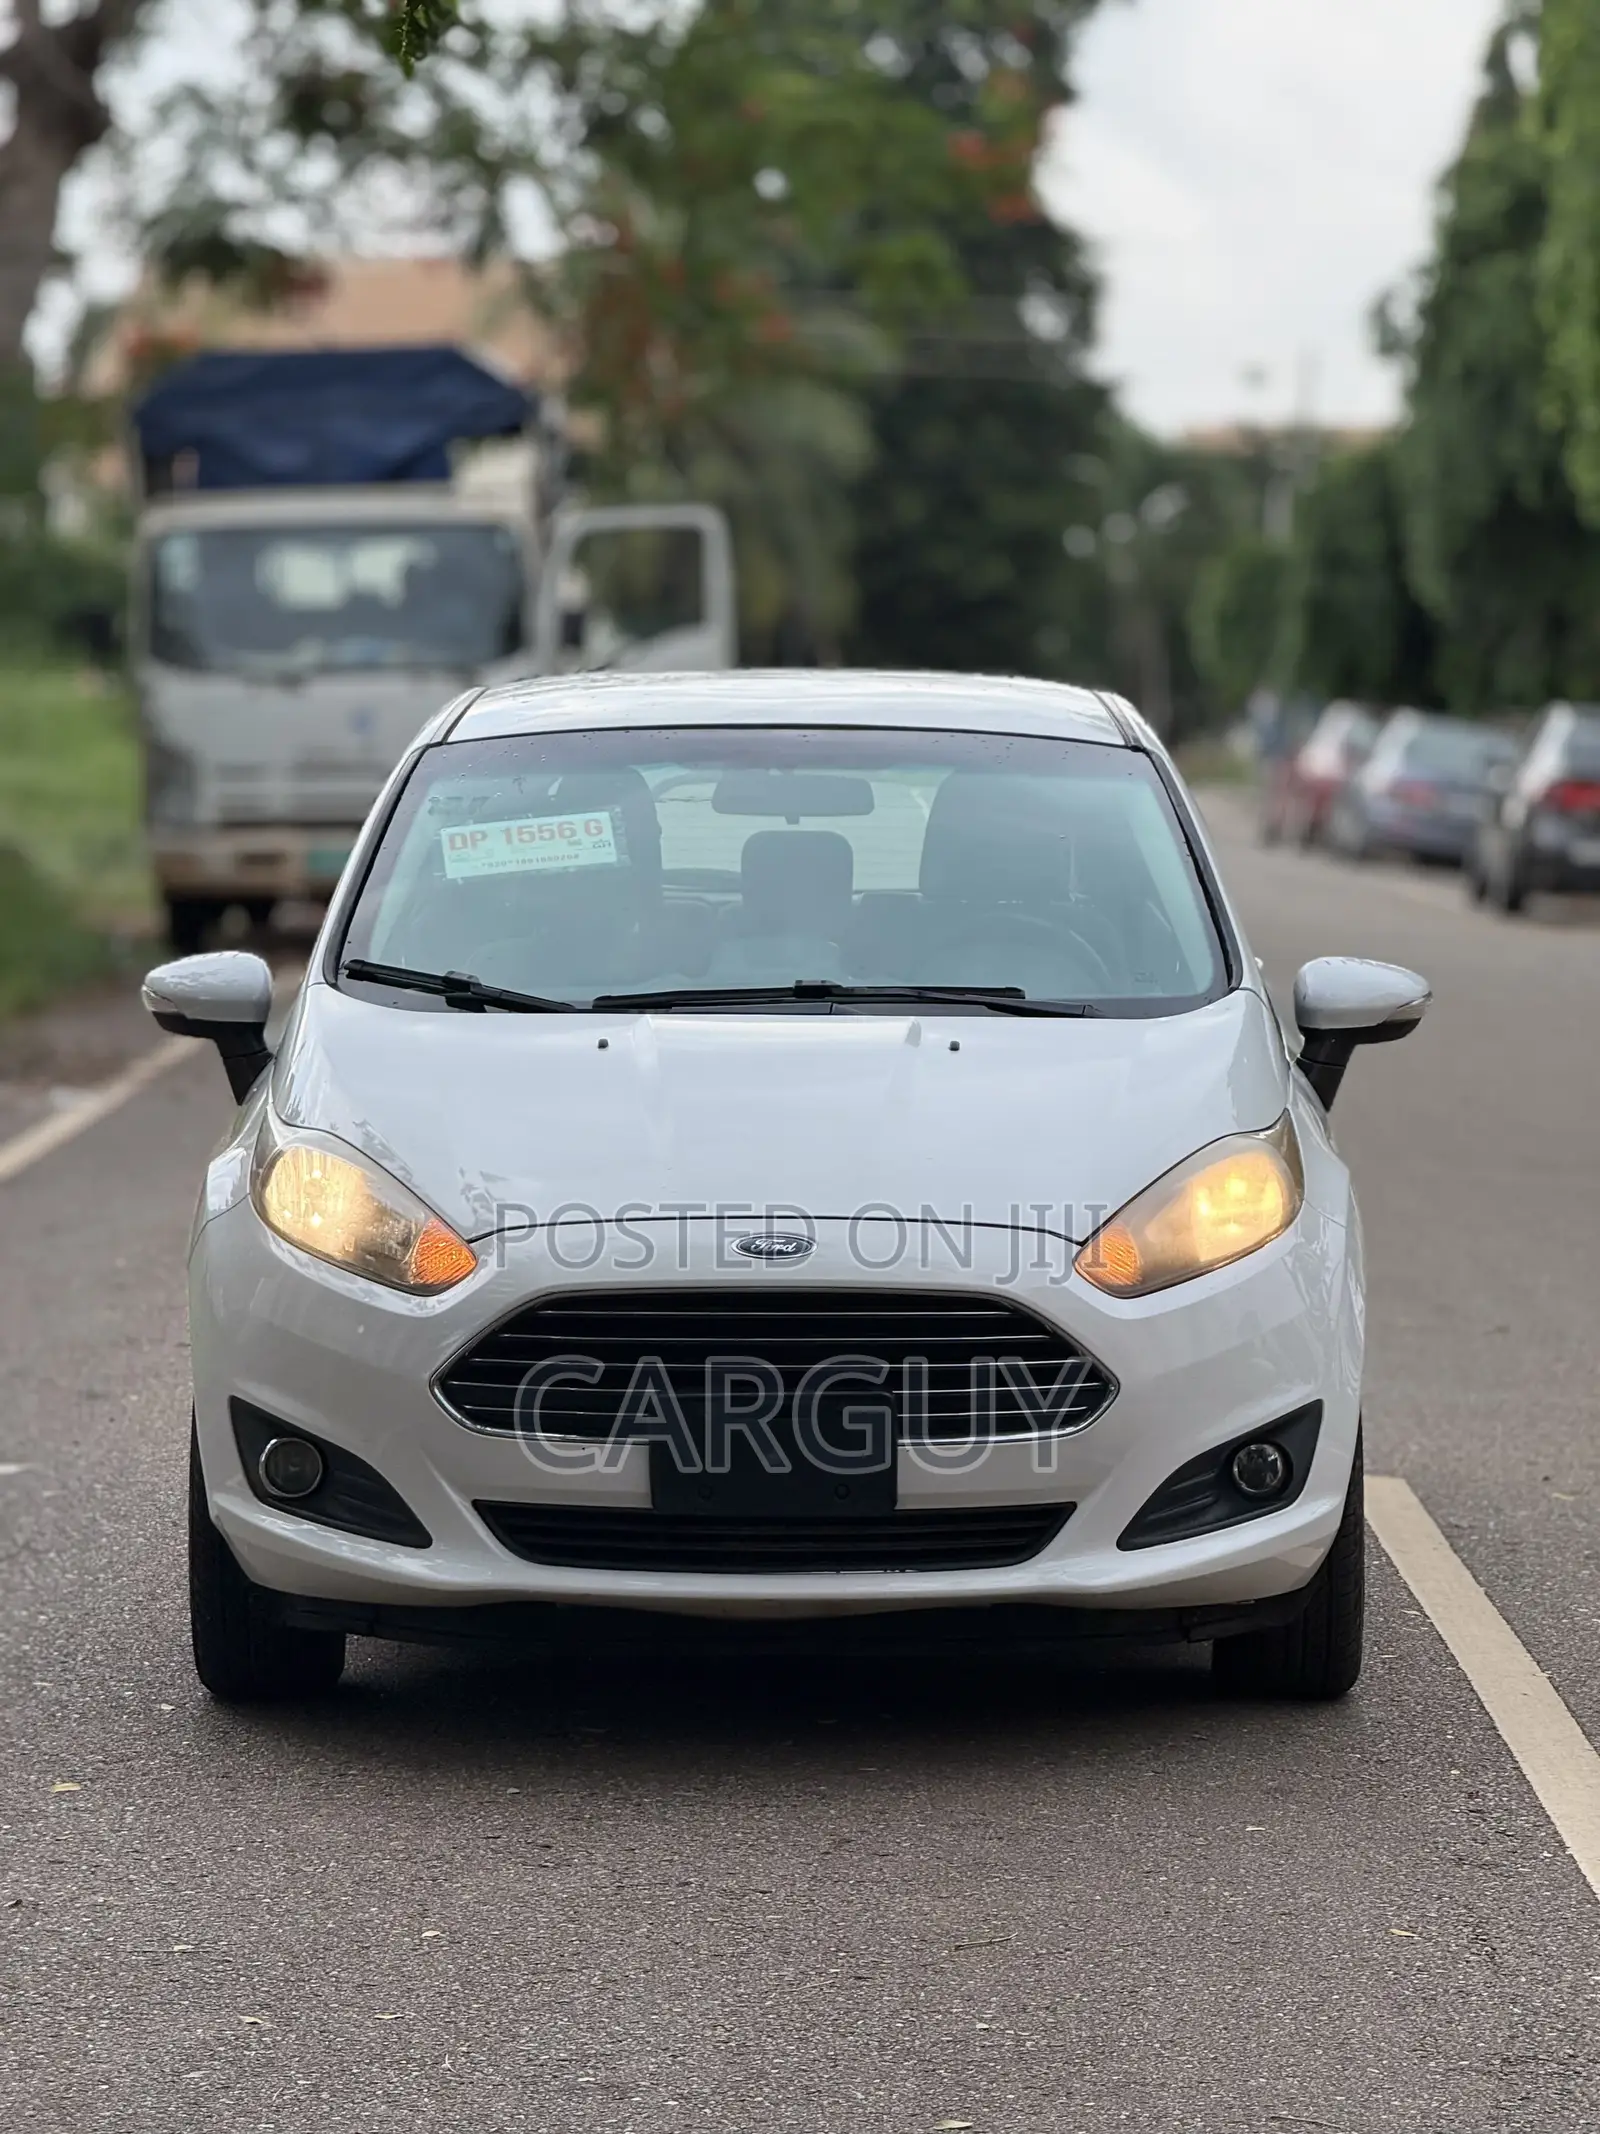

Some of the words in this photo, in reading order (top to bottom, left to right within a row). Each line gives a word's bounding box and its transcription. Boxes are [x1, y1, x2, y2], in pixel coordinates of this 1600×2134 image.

[448, 830, 488, 851] DP
[503, 821, 577, 845] 1556
[584, 818, 603, 837] G
[751, 1238, 797, 1252] Ford
